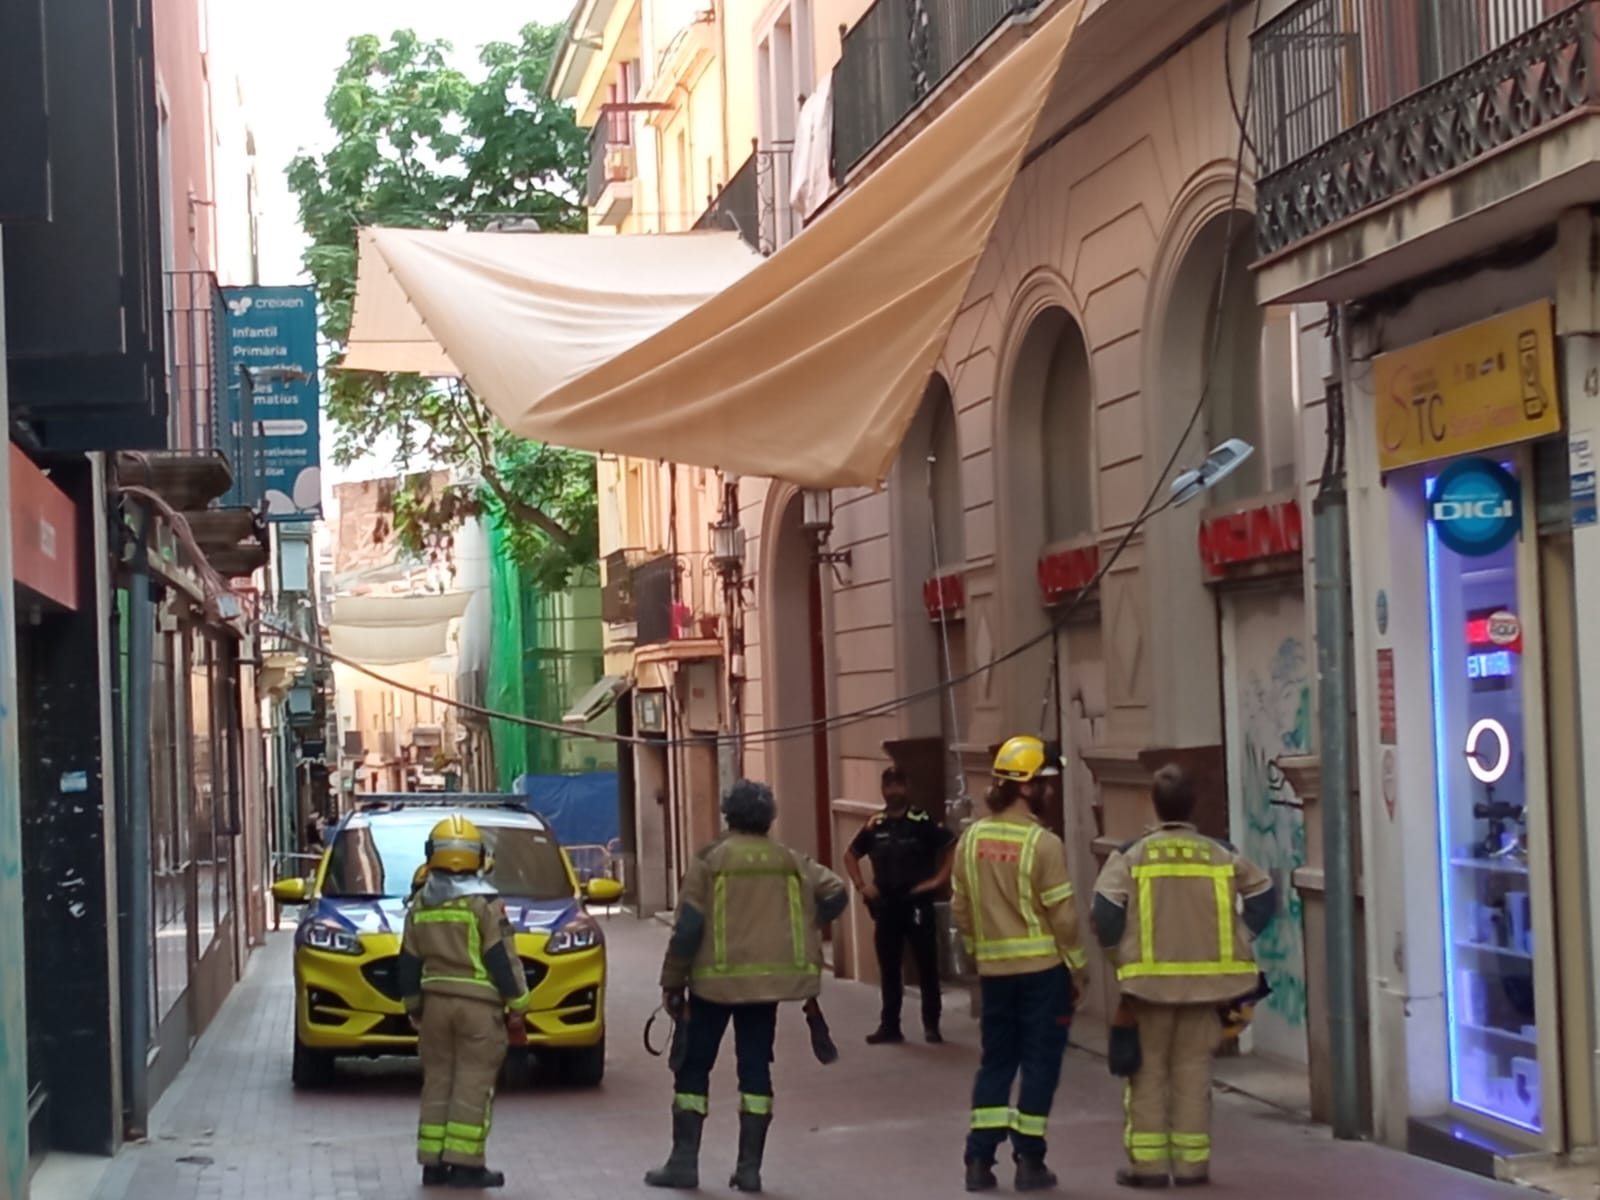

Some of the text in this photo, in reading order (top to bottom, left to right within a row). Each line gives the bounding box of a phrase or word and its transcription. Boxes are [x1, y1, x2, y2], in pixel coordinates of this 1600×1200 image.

[255, 296, 304, 309] creixen
[232, 326, 278, 338] Infantil
[233, 344, 288, 357] Primària
[1433, 500, 1513, 521] DIGI
